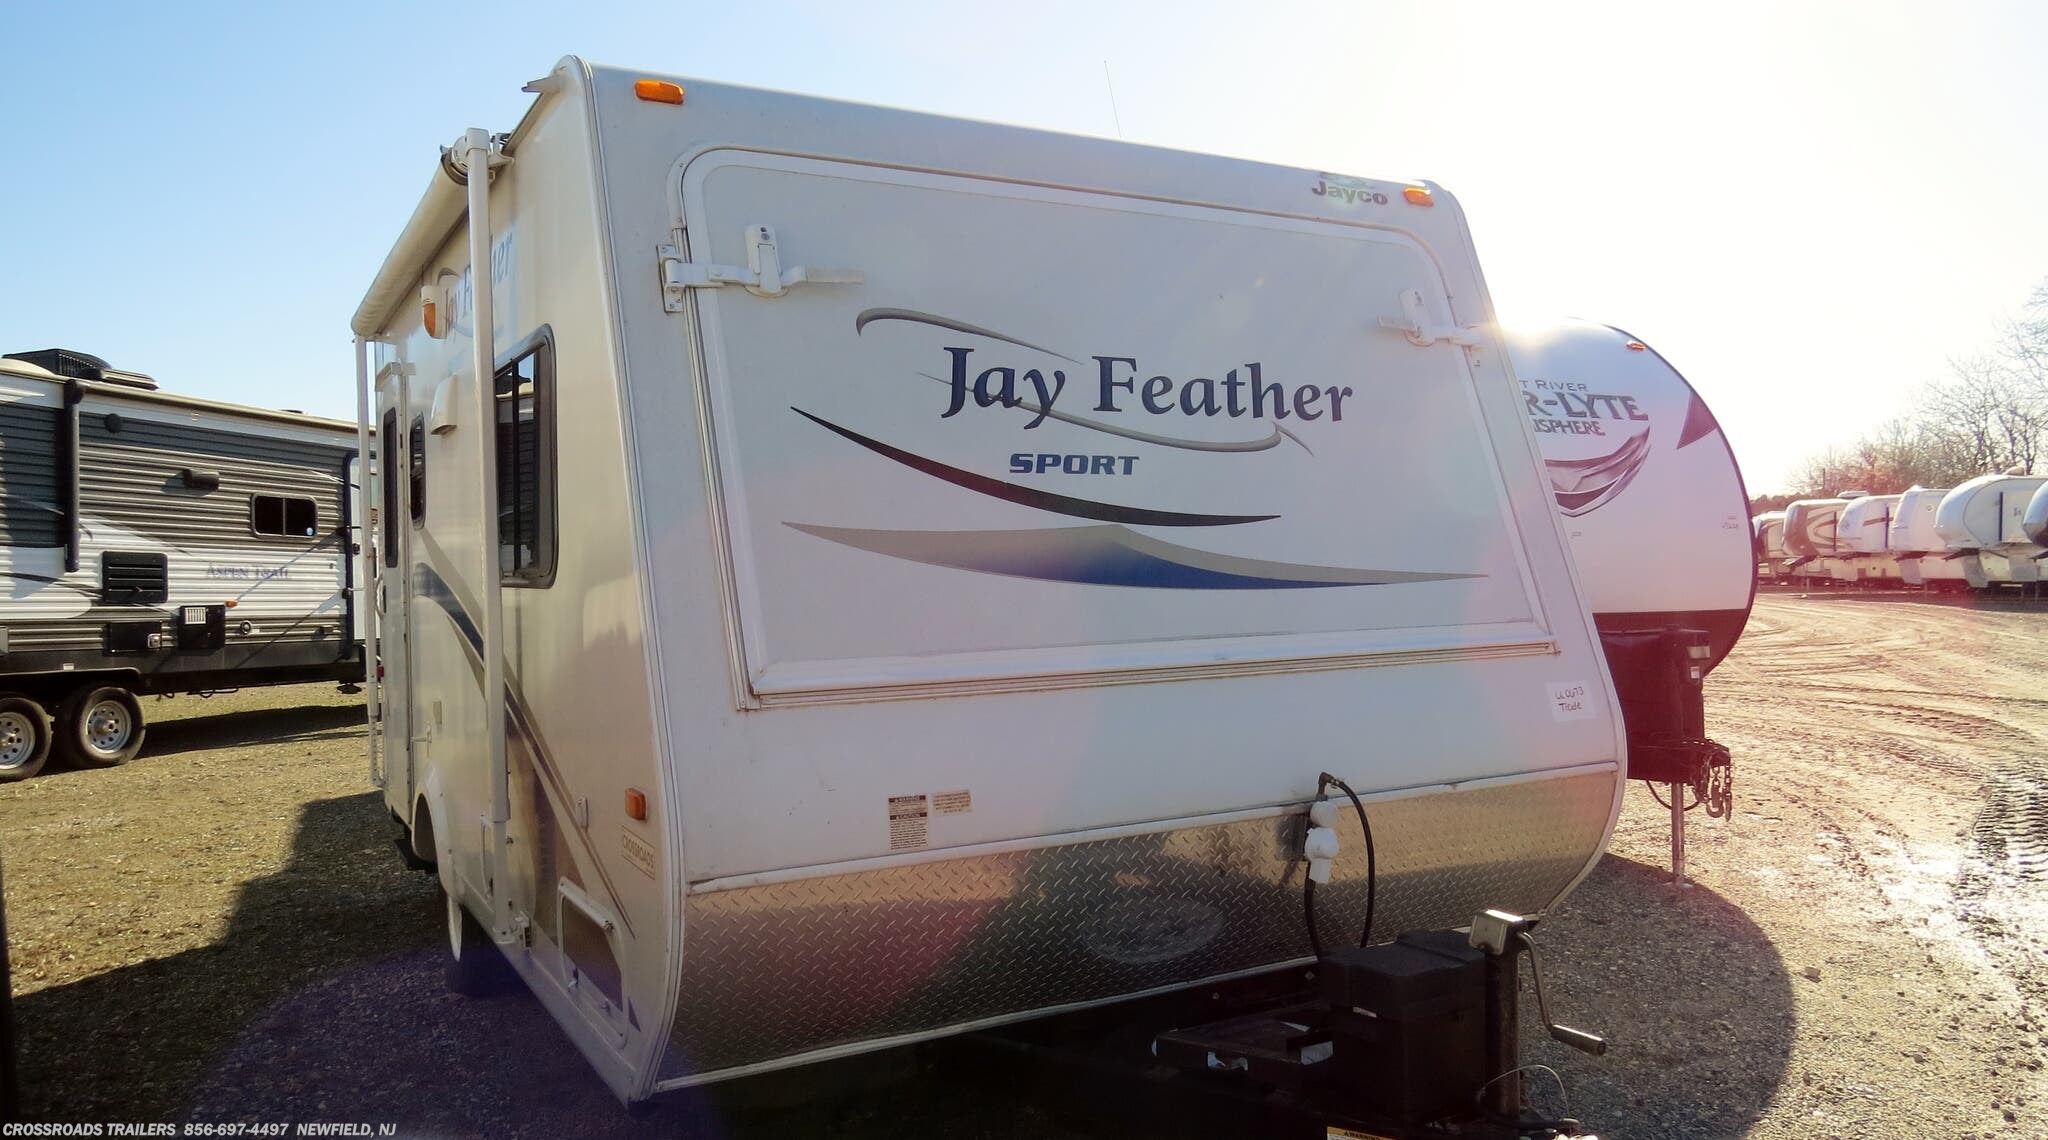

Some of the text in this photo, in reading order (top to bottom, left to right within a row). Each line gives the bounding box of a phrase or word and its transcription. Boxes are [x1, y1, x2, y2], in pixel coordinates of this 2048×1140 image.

[1311, 180, 1388, 205] Jayco
[940, 346, 1353, 429] Jay Feather
[1534, 379, 1589, 392] RIVER
[1009, 453, 1140, 476] SPORT
